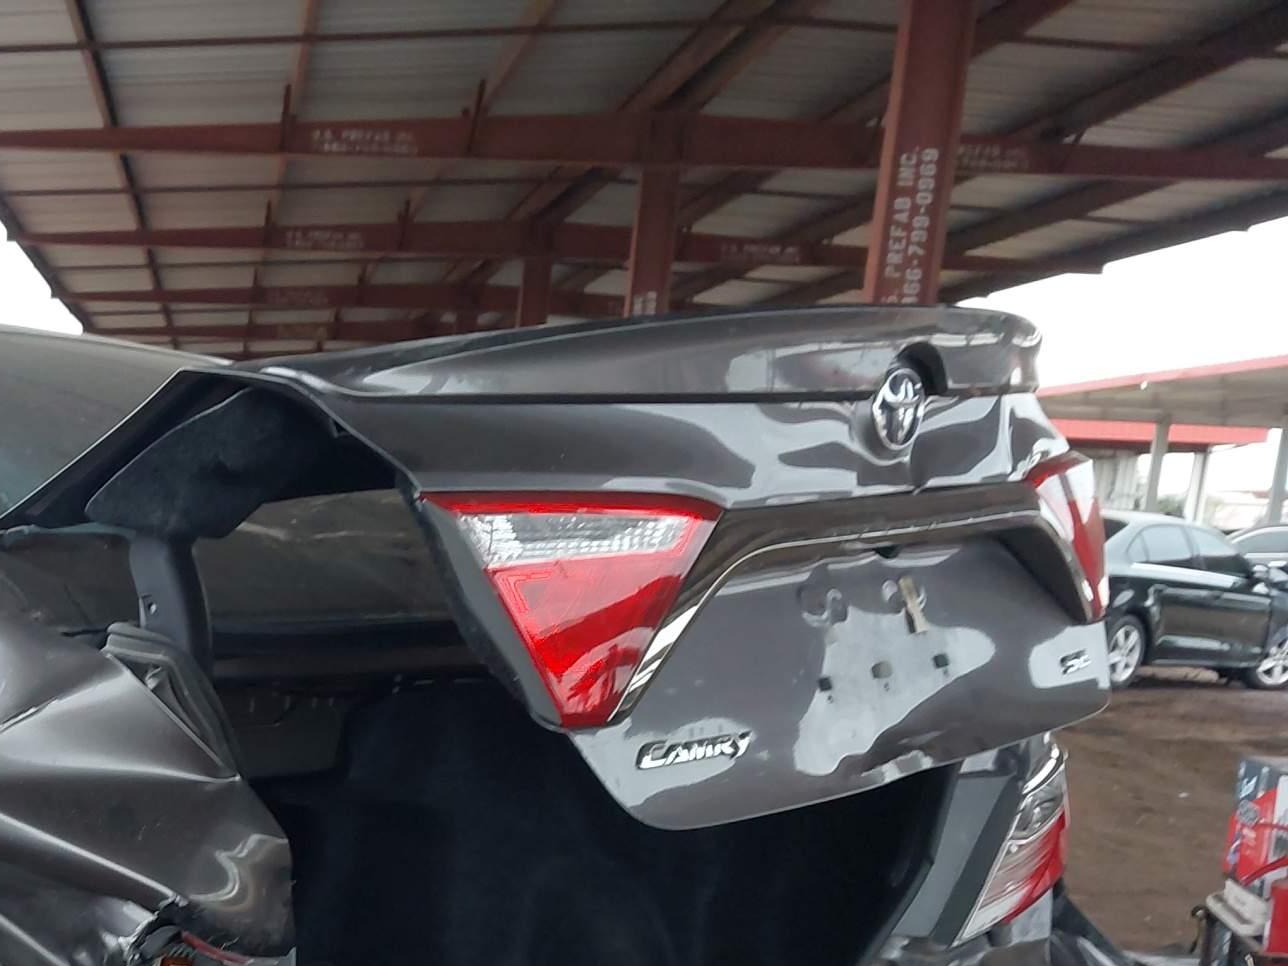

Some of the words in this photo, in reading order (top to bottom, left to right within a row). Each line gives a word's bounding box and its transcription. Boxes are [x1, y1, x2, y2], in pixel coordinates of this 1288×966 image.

[896, 145, 920, 187] INC.
[885, 196, 912, 279] PREFAB
[635, 730, 752, 770] CAMRY
